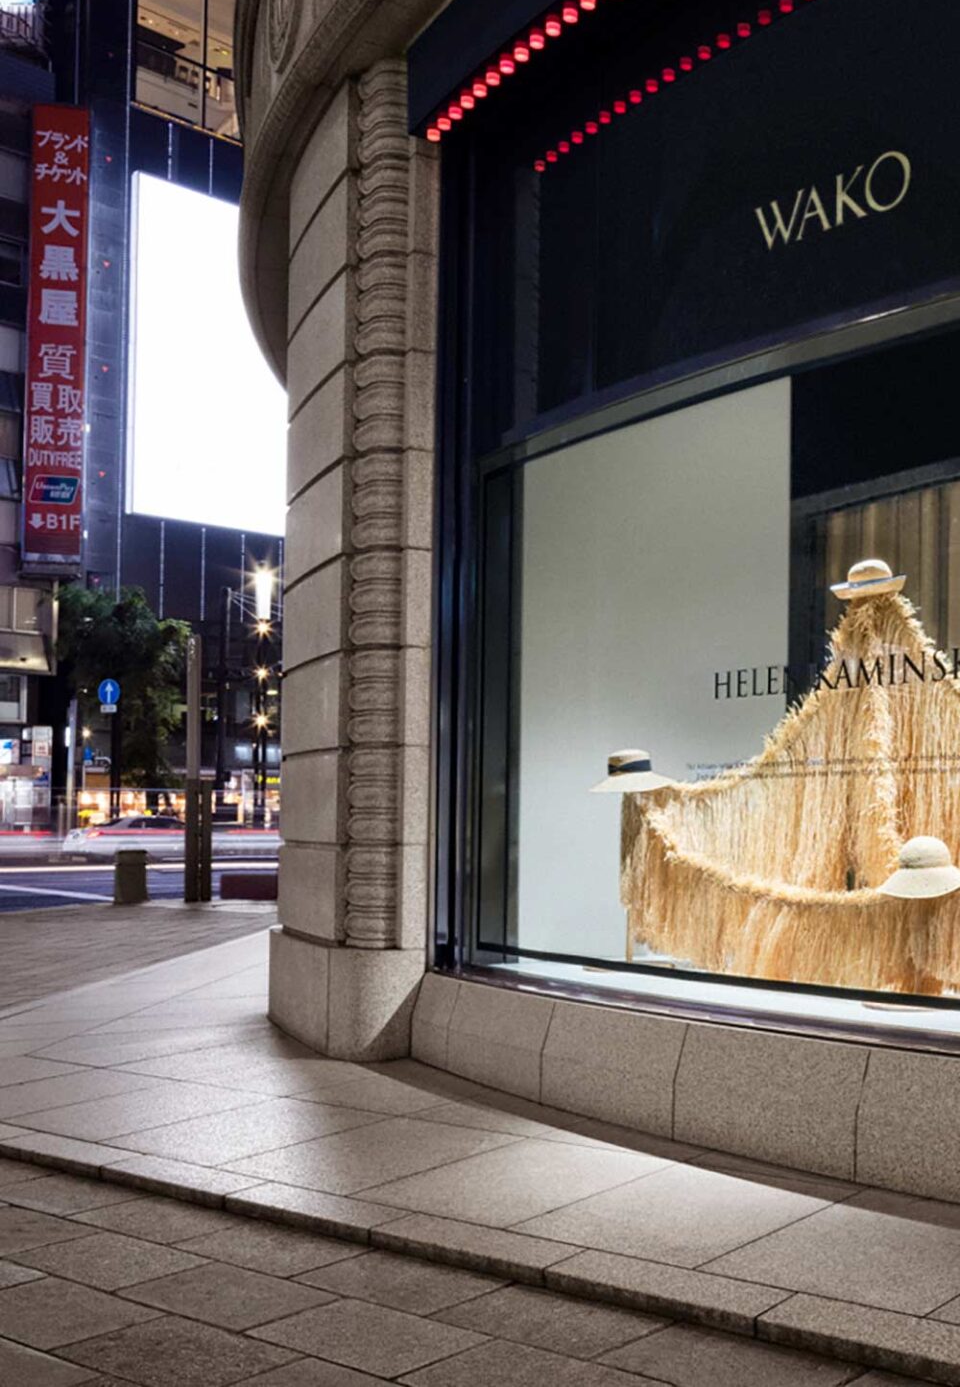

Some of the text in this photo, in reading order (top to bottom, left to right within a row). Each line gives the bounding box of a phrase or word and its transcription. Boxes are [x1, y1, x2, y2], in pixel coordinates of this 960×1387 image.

[36, 130, 88, 152] ブランド
[54, 151, 68, 165] &
[35, 163, 87, 185] チケット
[754, 150, 911, 251] WAKO
[39, 200, 80, 327] 大黒屋
[30, 415, 82, 446] 販売
[46, 514, 81, 531] B1F
